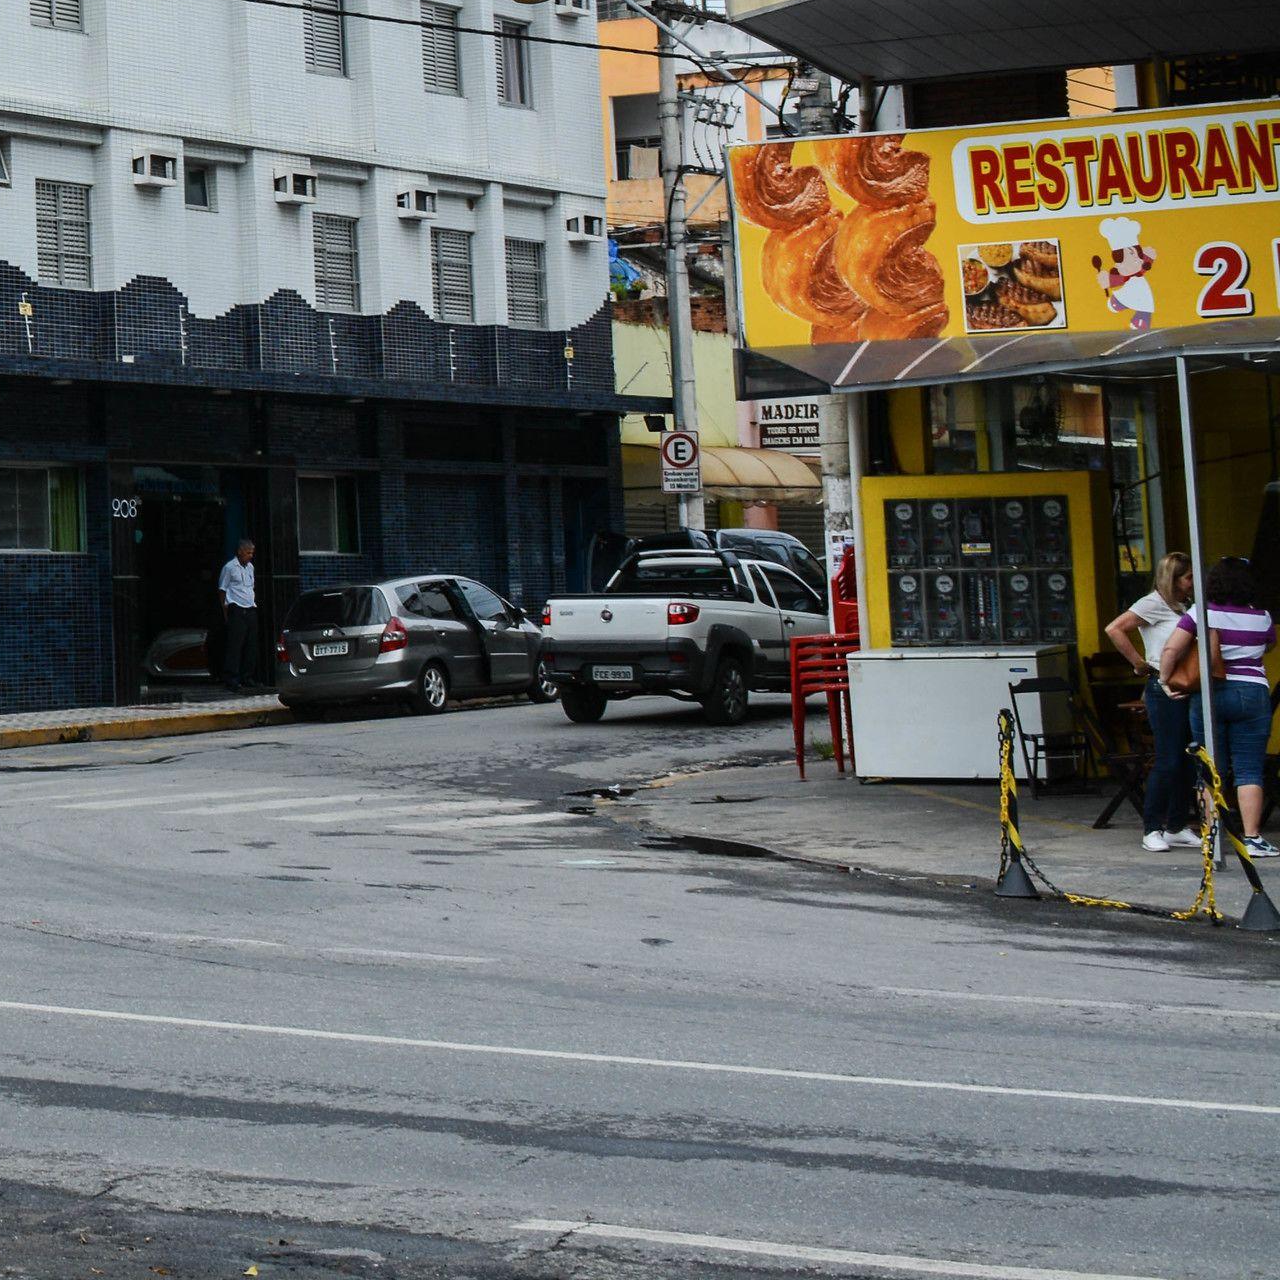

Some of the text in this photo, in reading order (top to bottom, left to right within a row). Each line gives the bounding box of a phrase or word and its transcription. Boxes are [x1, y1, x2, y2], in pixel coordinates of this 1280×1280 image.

[1194, 241, 1252, 317] 2
[674, 442, 686, 460] E
[112, 498, 137, 518] 208
